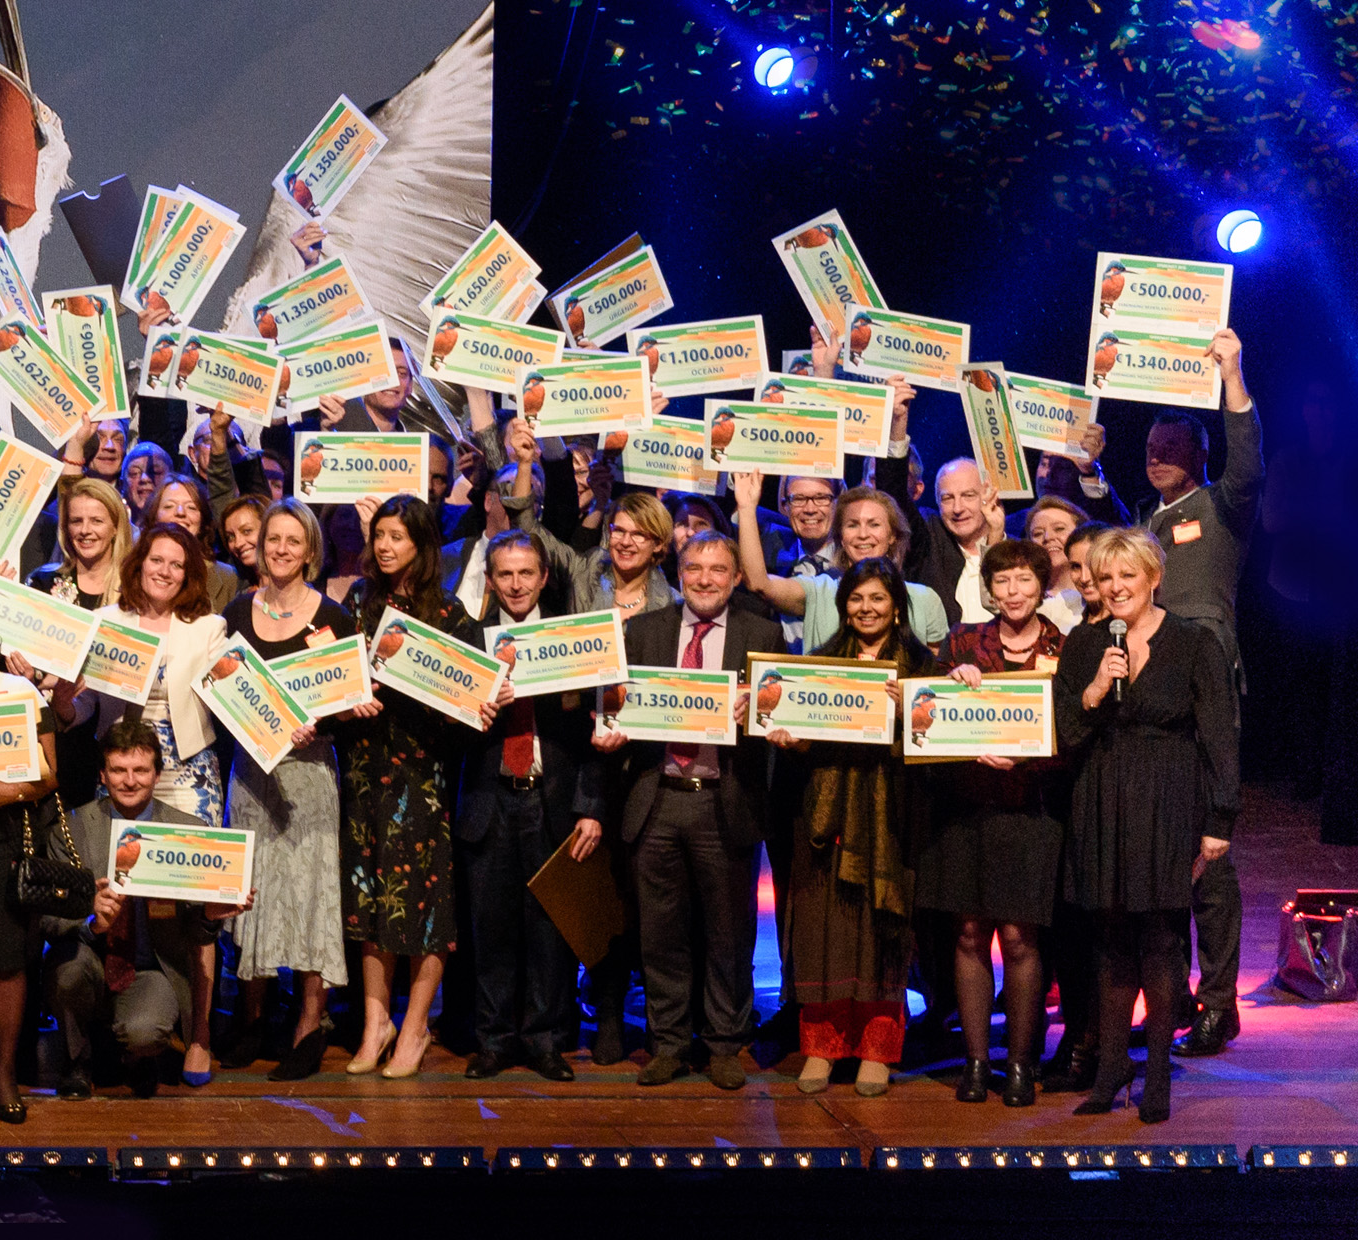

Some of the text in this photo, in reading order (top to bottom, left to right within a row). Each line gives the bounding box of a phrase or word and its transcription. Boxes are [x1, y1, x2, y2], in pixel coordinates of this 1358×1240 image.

[305, 123, 360, 188] €1.350.000,-
[158, 219, 215, 298] €1.000.000,-
[274, 281, 349, 325] €1.350.000,-
[587, 278, 649, 315] €500.000,-
[1129, 282, 1211, 303] €500.000,-
[659, 345, 753, 366] €1.100.000,-
[875, 334, 951, 359] €500.000,-
[197, 356, 269, 393] €1.350.000,-
[296, 350, 373, 378] €500.000,-
[691, 367, 725, 376] OCEANA
[1115, 353, 1210, 377] €1.340.000,-
[10, 345, 78, 417] €2.625.000,-
[551, 385, 631, 401] €900.000,-
[574, 406, 609, 416] RUTGERS
[1014, 400, 1079, 427] €500.000,-
[741, 428, 824, 445] €500.000,-
[322, 457, 416, 474] €2.500.000,-
[515, 638, 612, 663] €1.800.000,-
[406, 646, 480, 693] €500.000,-
[307, 690, 323, 702] ARK
[412, 671, 460, 699] THEIRWORLD
[234, 673, 285, 735] €900.000,-
[626, 691, 723, 713] €1.350.000,-
[787, 691, 874, 711] €500.000,-
[664, 715, 683, 723] ICCO
[807, 712, 852, 723] AFLATOUN
[929, 708, 1043, 725] €10.000.000,-
[146, 849, 231, 871] €500.000,-
